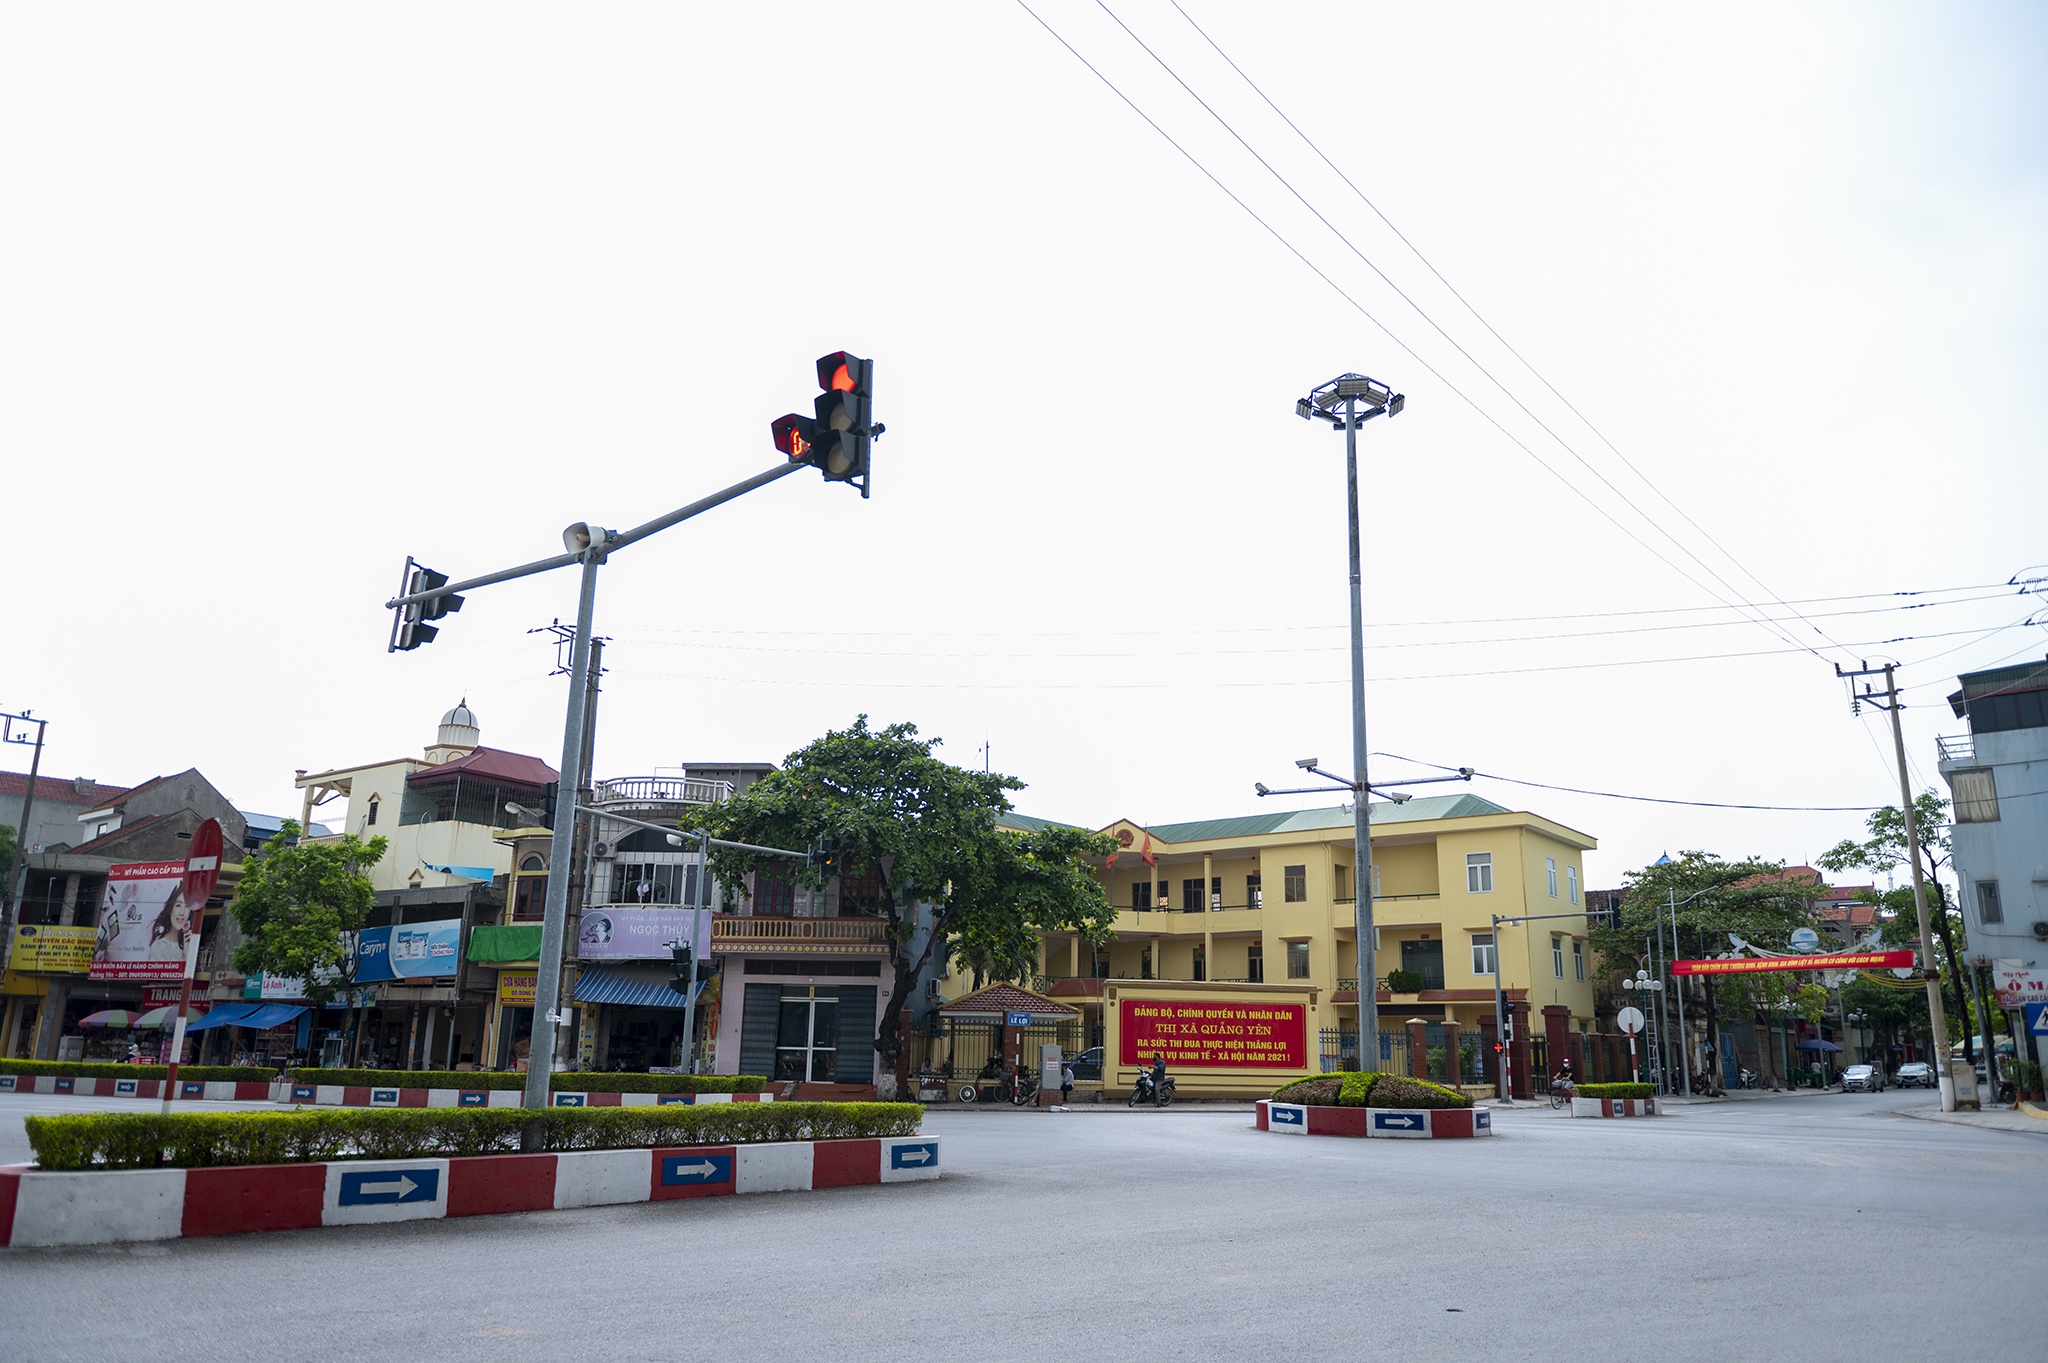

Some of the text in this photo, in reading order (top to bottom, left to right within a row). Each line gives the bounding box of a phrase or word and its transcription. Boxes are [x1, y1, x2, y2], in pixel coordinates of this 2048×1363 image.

[630, 922, 690, 935] NGỌC THỦY
[360, 942, 382, 957] Caryn
[263, 980, 270, 991] Lệ
[271, 981, 282, 989] Anh
[2008, 979, 2022, 991] Ô
[151, 989, 182, 1000] TRANG
[1134, 1005, 1292, 1020] ĐẢNG BỘ, CHÍNH QUYỀN VÀ NHÂN DÂN
[1156, 1021, 1271, 1035] THỊ XÃ QUẢNG YÊN
[1137, 1039, 1148, 1047] RA
[1151, 1037, 1167, 1047] SỨC
[1184, 1040, 1200, 1048] ĐUA
[1202, 1040, 1223, 1050] THỰC
[1225, 1040, 1244, 1050] HIỆN
[1246, 1039, 1272, 1050] THẮNG
[1274, 1041, 1286, 1051] LỢI
[1166, 1051, 1176, 1061] VỤ
[1179, 1051, 1199, 1060] KINH
[1201, 1050, 1210, 1060] TẾ
[1218, 1051, 1229, 1060] XÃ
[1231, 1051, 1244, 1062] HỘI
[1247, 1051, 1265, 1061] NĂM
